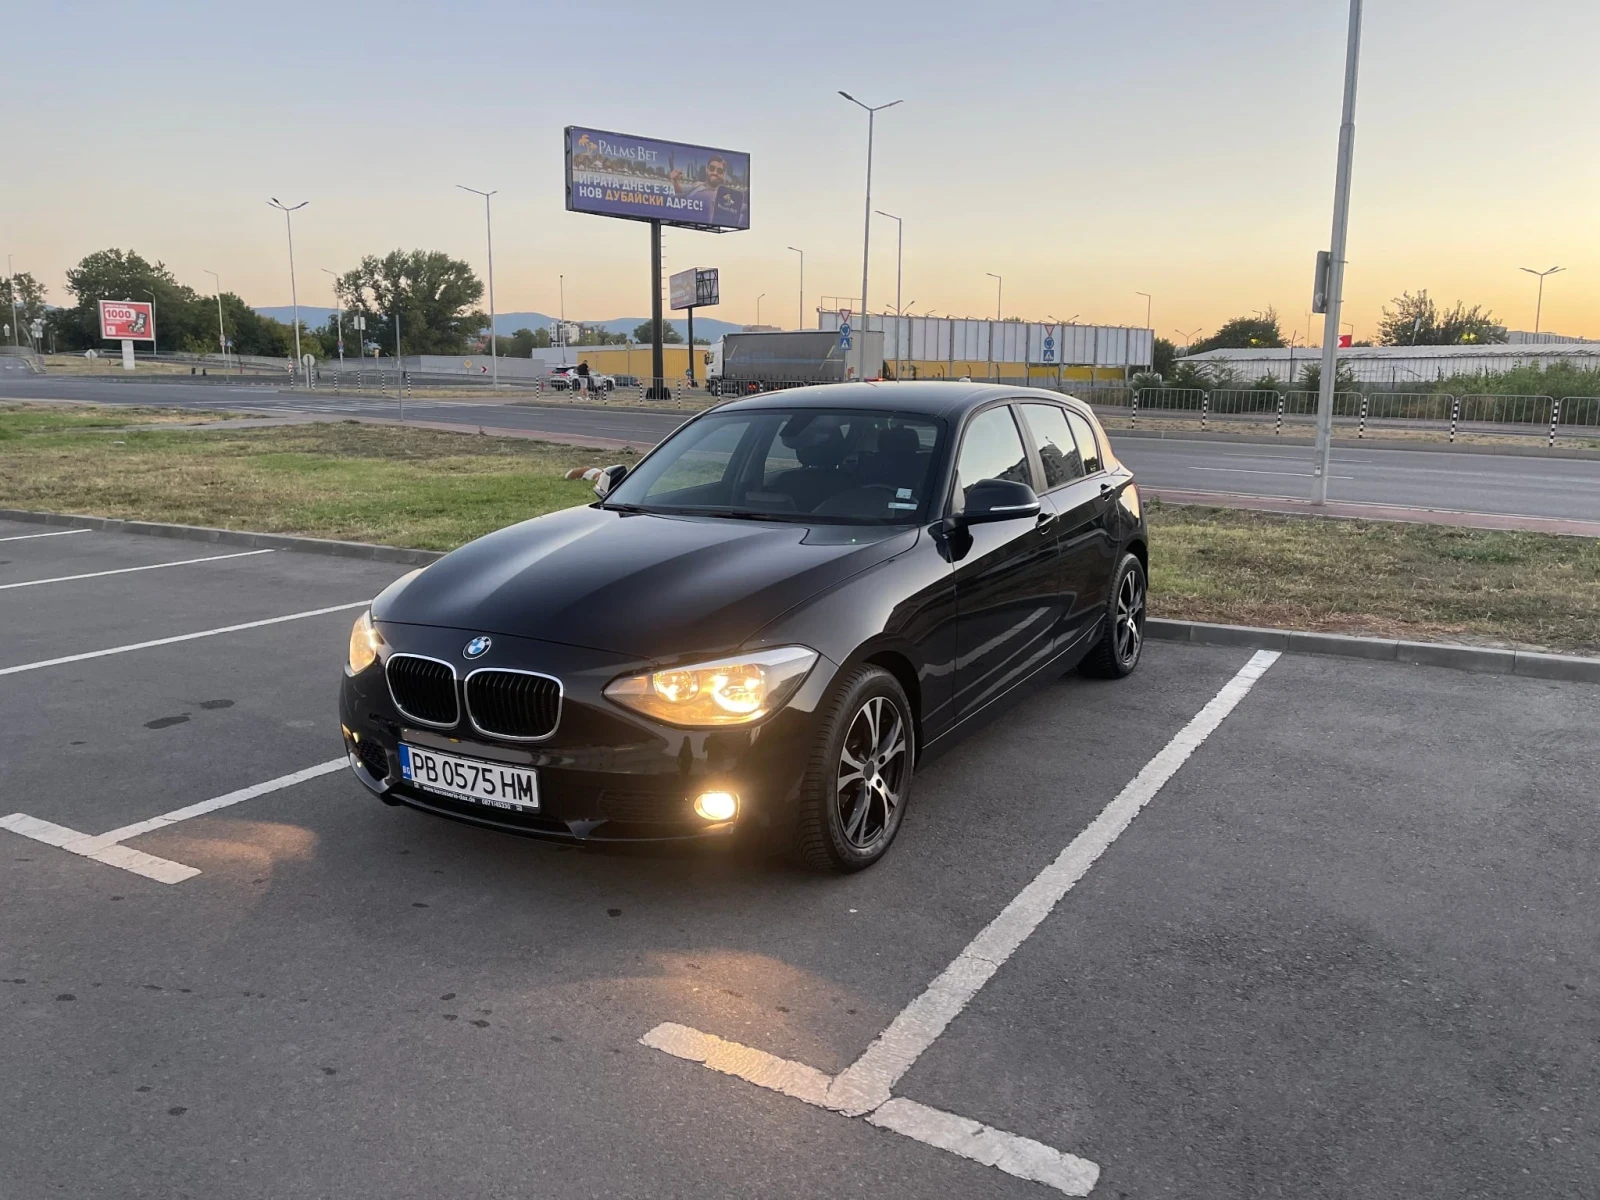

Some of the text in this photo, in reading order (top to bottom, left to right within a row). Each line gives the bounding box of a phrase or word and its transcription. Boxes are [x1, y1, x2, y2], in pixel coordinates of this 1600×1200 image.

[598, 139, 658, 162] PALMS BET
[579, 173, 676, 196] ИГРАТА ДНЕС Е ЗА
[579, 185, 603, 199] НОВ
[605, 188, 664, 207] ДУБАЙСКИ
[666, 196, 703, 211] АДРЕС!
[105, 309, 131, 319] 1000
[402, 765, 411, 774] BG
[412, 751, 534, 803] PB 0575 HM
